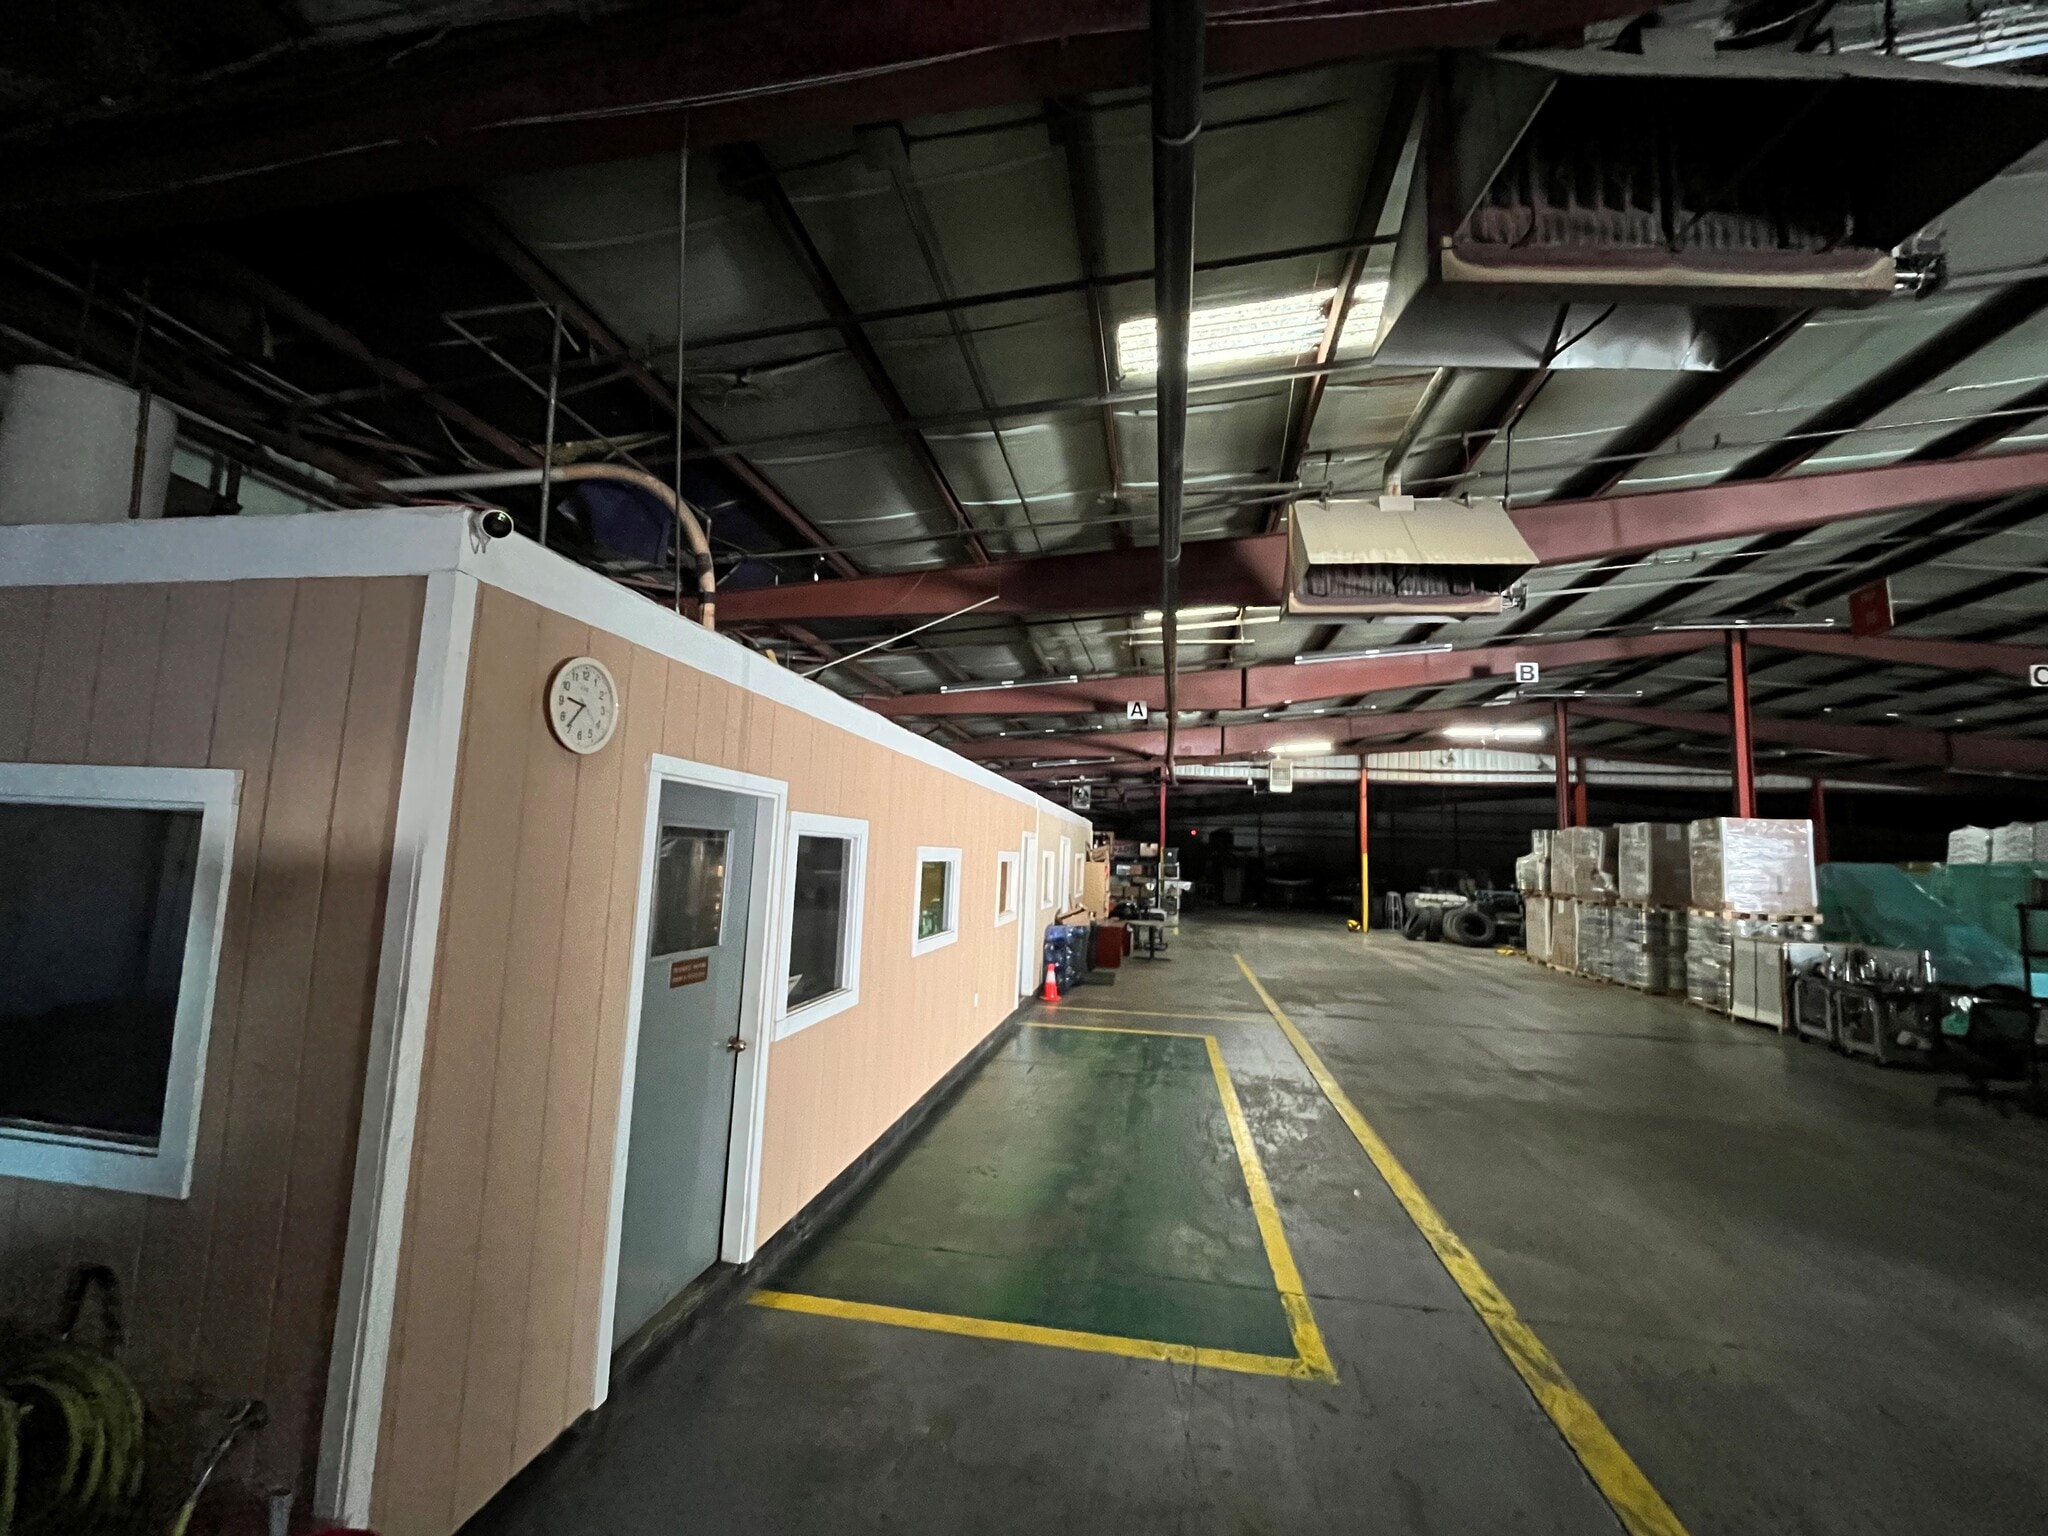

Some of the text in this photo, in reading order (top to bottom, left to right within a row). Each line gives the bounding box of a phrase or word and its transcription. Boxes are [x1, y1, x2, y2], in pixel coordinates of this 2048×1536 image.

[572, 671, 579, 682] 11
[583, 671, 590, 681] 12
[1520, 665, 1534, 680] B
[2034, 666, 2048, 685] C
[563, 680, 571, 691] 10
[559, 695, 564, 706] 9
[598, 691, 604, 700] 2
[600, 706, 605, 716] 3
[1131, 702, 1143, 717] A
[560, 711, 566, 721] 8
[595, 720, 601, 729] 4
[577, 730, 582, 740] 6
[588, 728, 593, 738] 5
